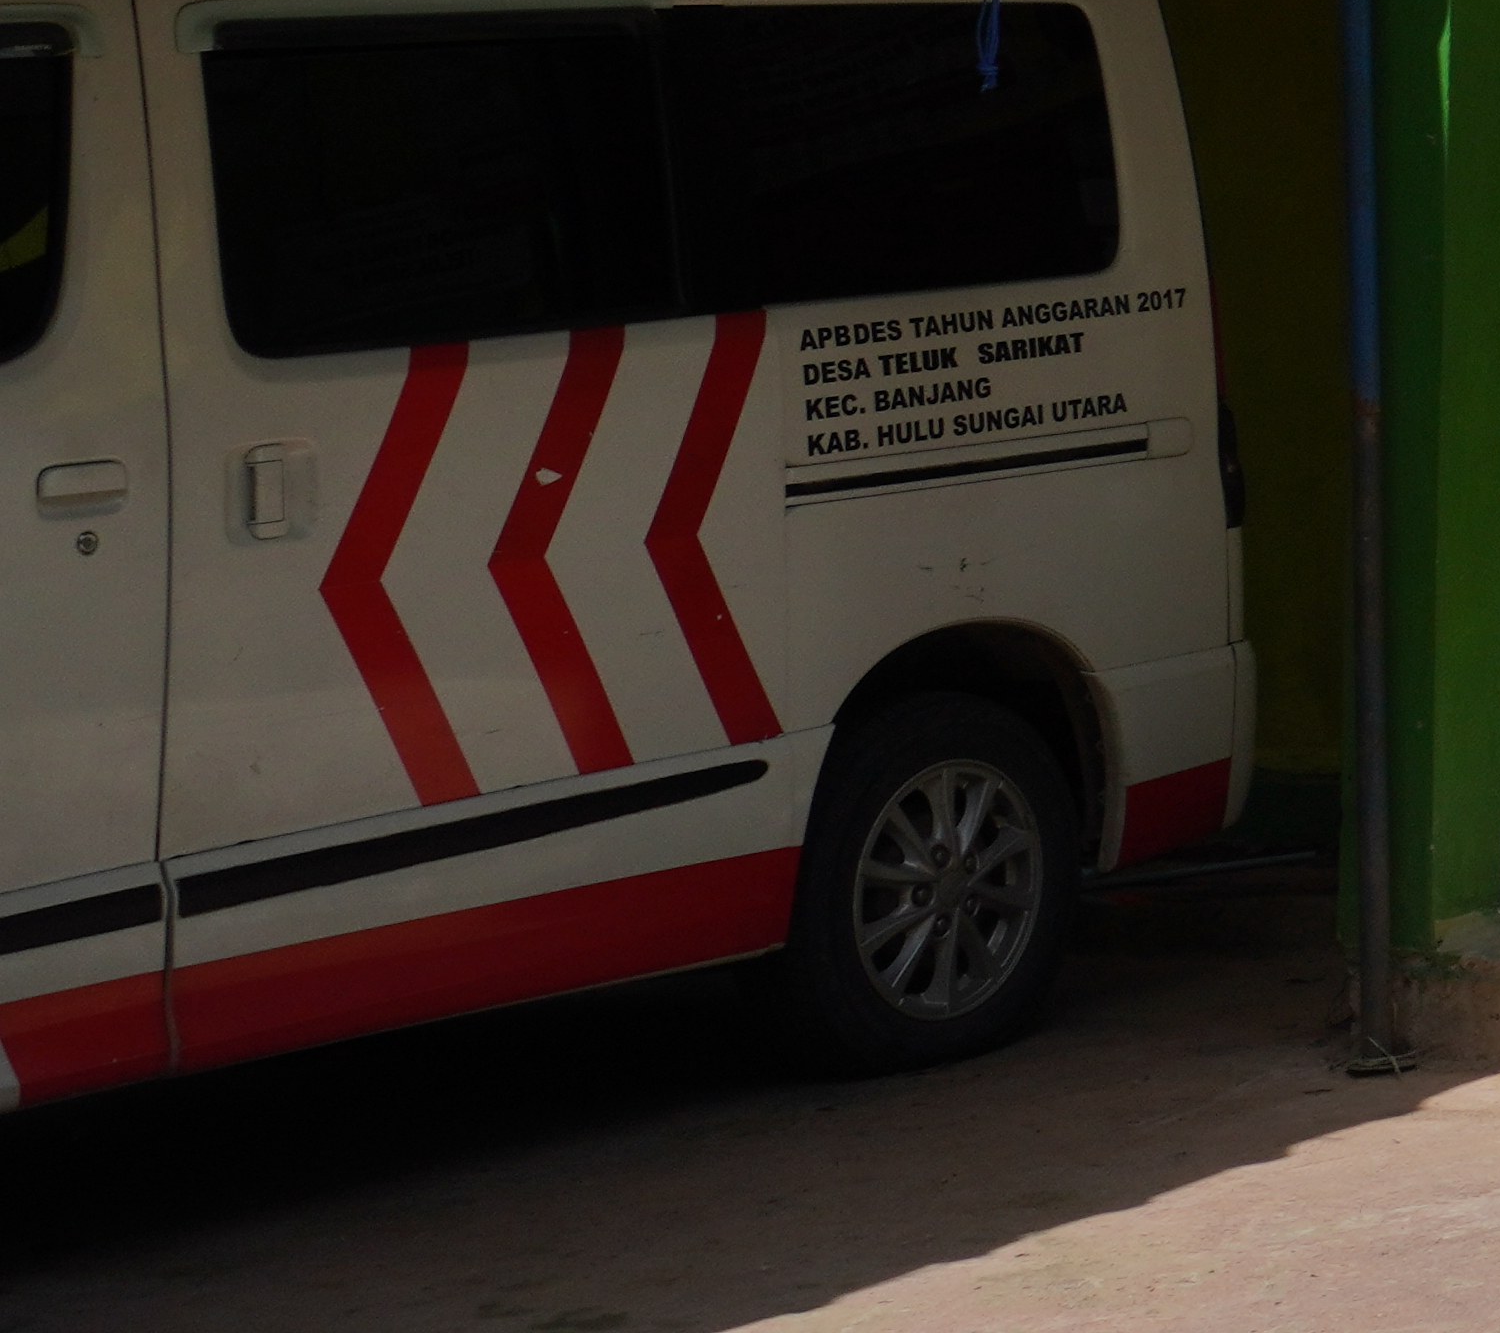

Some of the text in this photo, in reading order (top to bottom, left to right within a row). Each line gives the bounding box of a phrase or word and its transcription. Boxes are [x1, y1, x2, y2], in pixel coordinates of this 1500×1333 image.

[800, 288, 1187, 351] APBDES TAHUN ANGGARAN 2017
[803, 332, 1085, 386] DESA TELUK SARIKAT
[806, 377, 991, 421] KEC. BANJANG
[807, 393, 1127, 456] KAB. HULU SUNGAI UTARA
